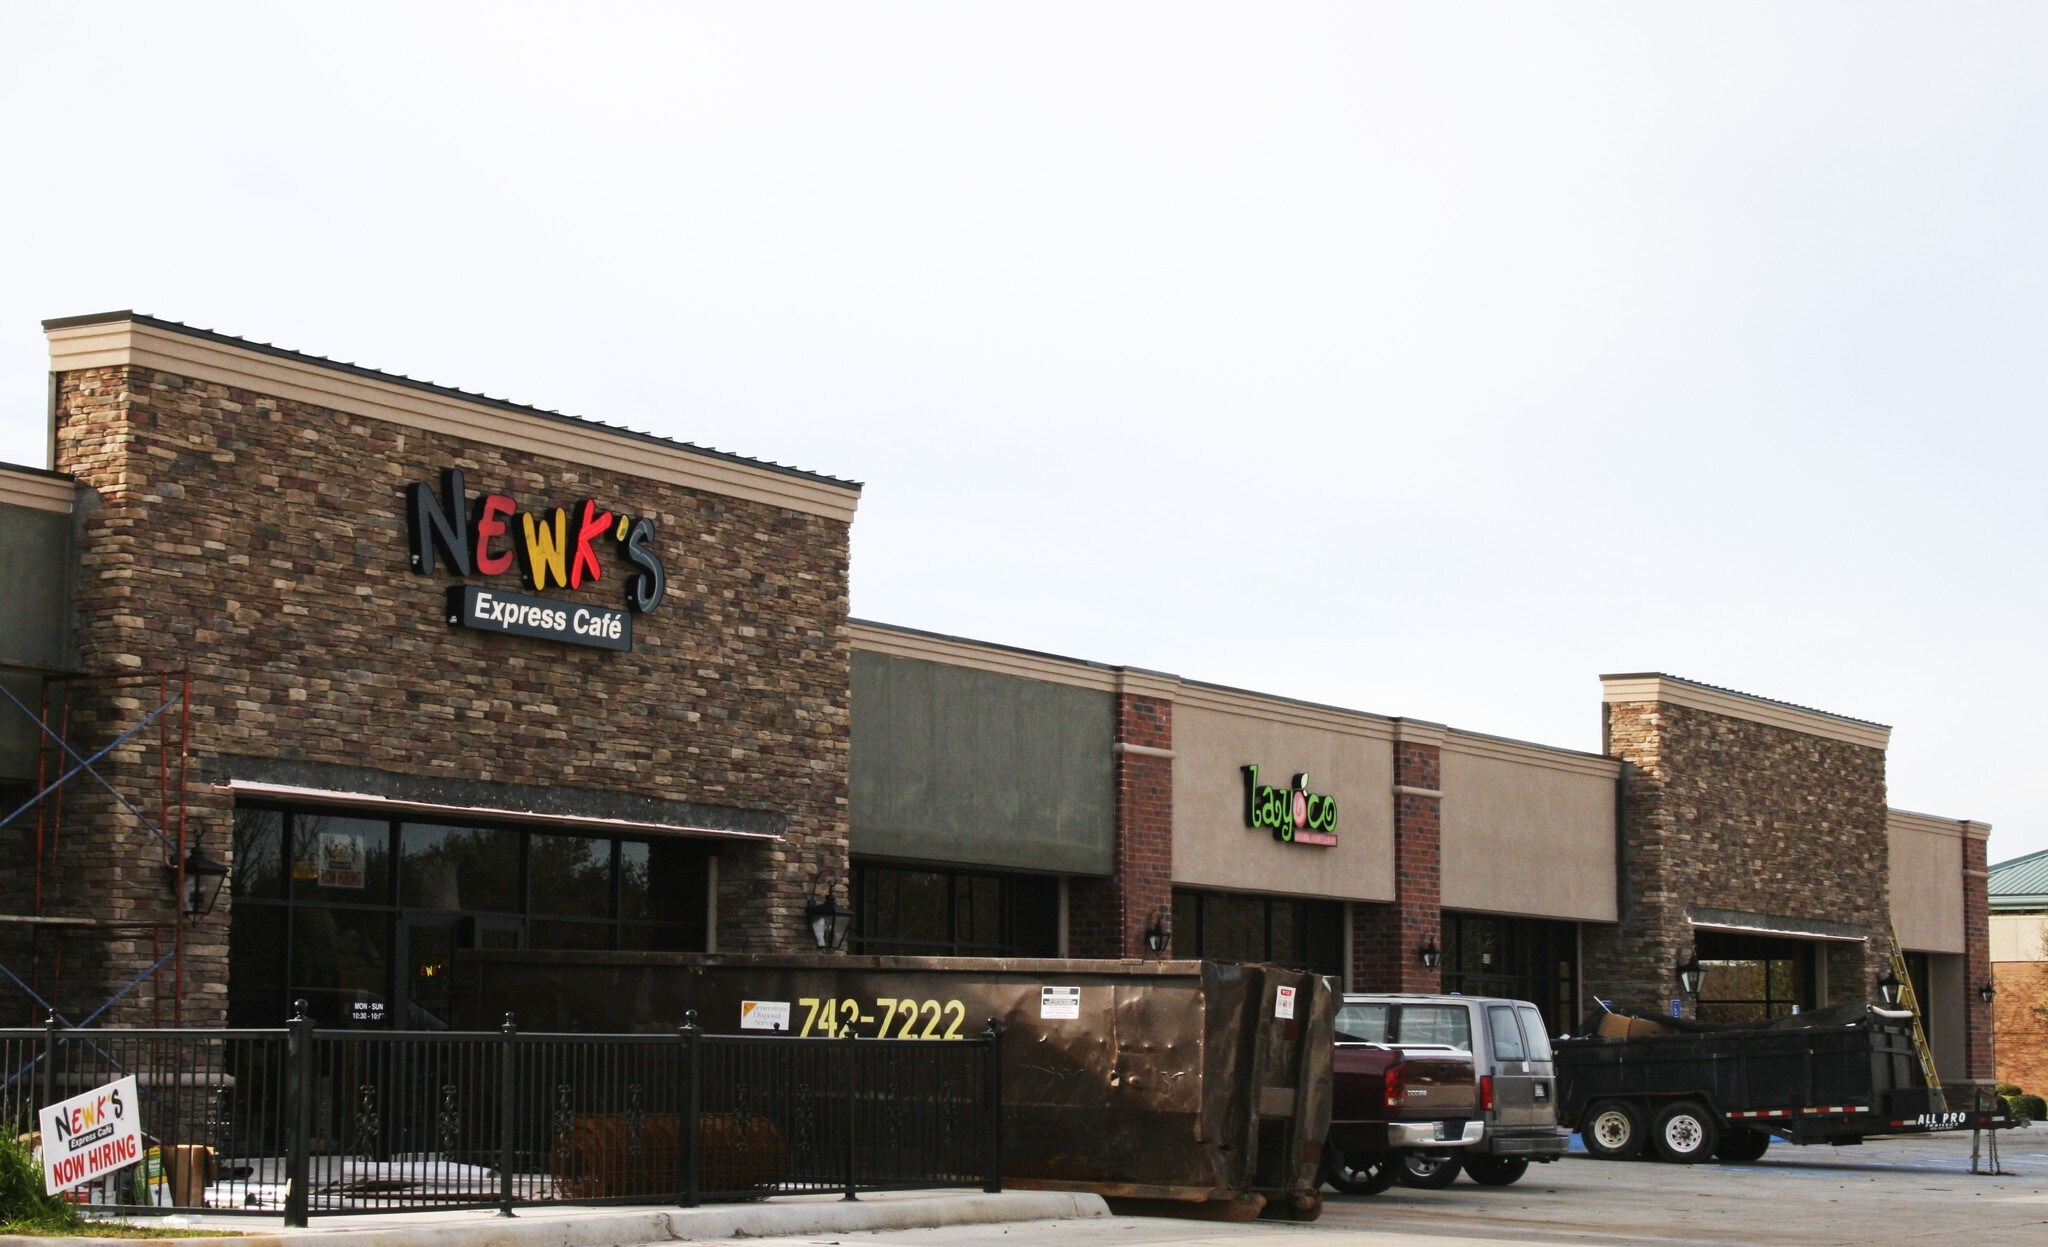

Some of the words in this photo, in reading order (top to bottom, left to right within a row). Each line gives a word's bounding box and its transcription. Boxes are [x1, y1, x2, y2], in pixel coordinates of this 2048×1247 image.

[409, 469, 664, 613] NEWK'S
[474, 592, 566, 628] Express
[573, 608, 622, 639] Café
[354, 1002, 367, 1010] MON
[372, 1003, 384, 1011] SUN
[799, 998, 966, 1038] 742-7222
[55, 1089, 123, 1142] NEWK'S
[70, 1131, 96, 1148] Express
[98, 1124, 112, 1137] Café
[1917, 1113, 1937, 1125] ALL
[1942, 1112, 1966, 1124] PRO
[53, 1153, 84, 1187] NOW
[89, 1134, 136, 1173] HIRING
